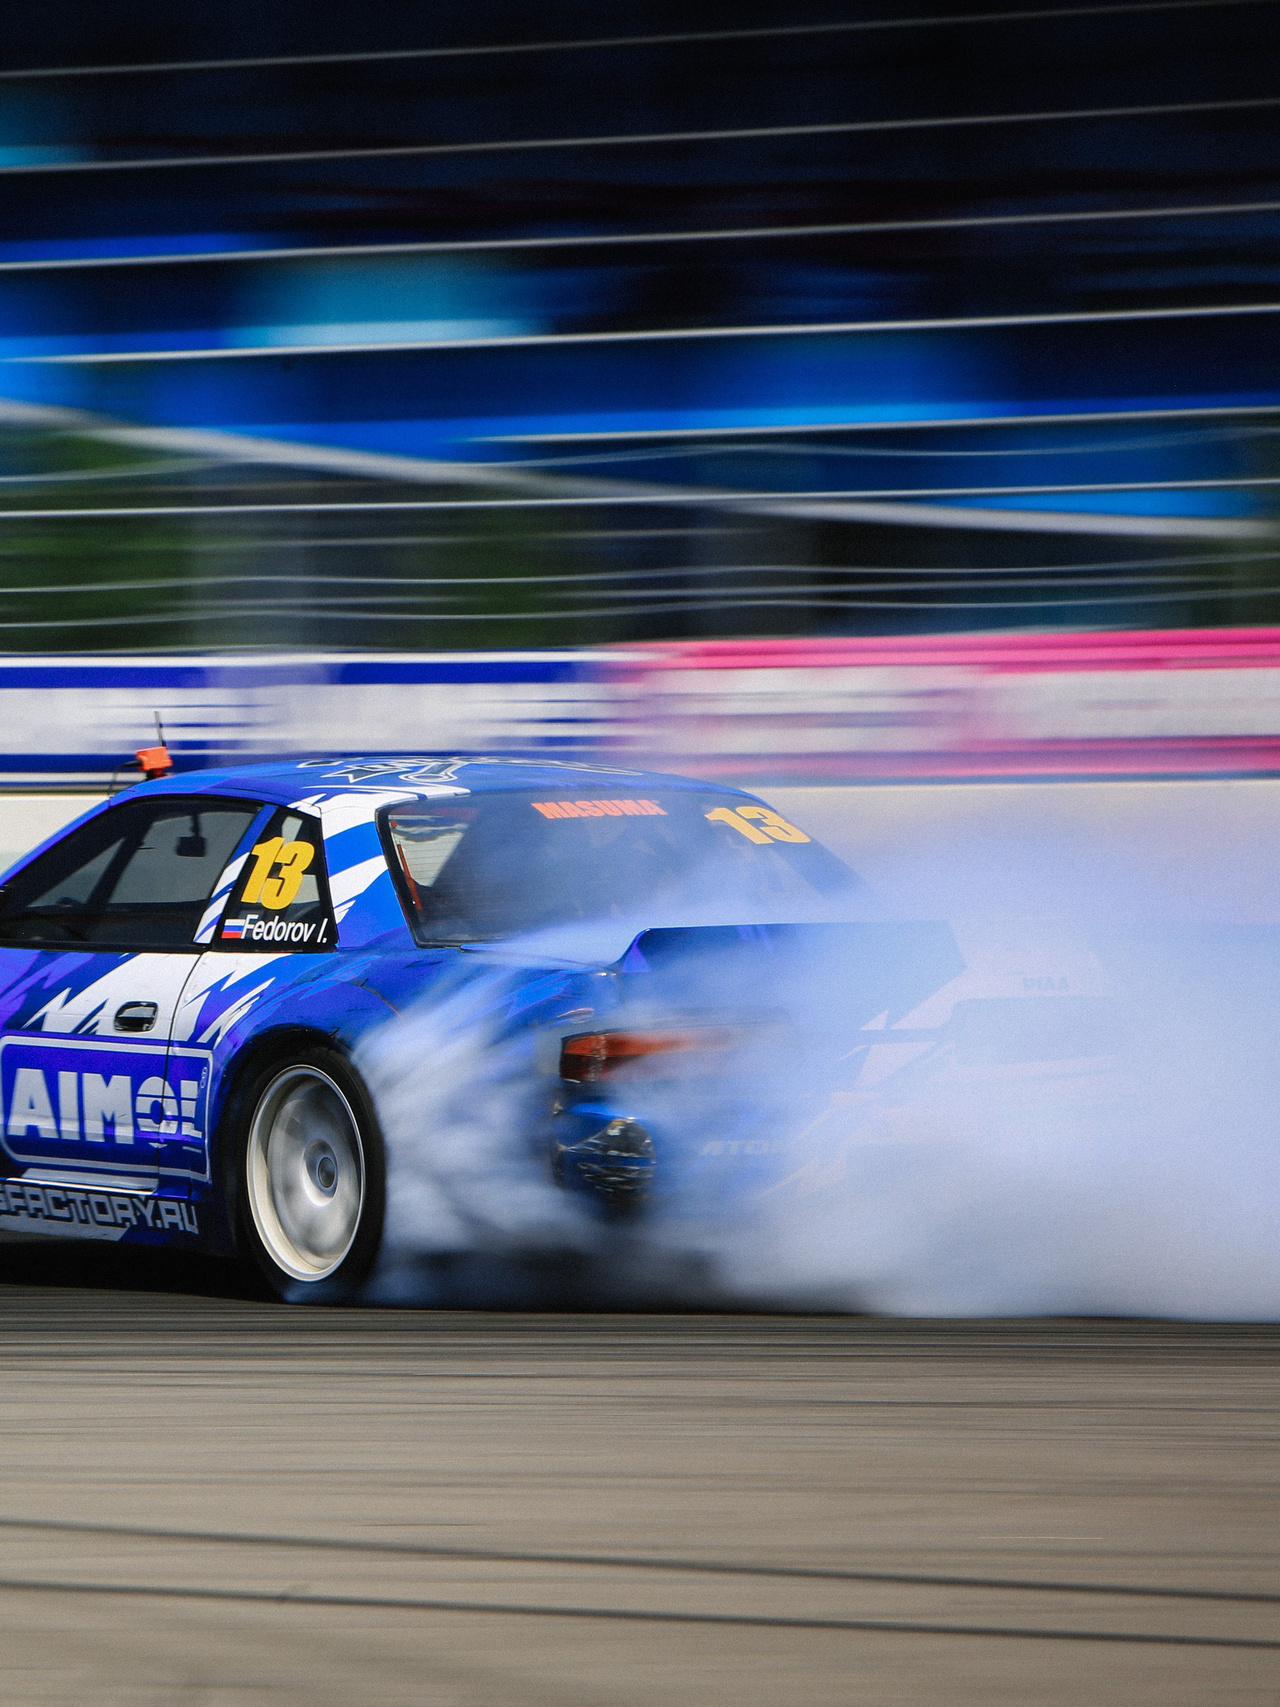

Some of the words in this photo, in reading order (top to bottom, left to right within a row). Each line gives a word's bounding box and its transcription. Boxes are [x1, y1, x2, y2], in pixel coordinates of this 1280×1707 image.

[531, 800, 668, 819] MASUMA
[704, 806, 811, 844] 13
[240, 836, 315, 910] 13
[241, 914, 316, 942] Fedorov
[317, 918, 328, 943] I.
[7, 1067, 203, 1153] AIMOL
